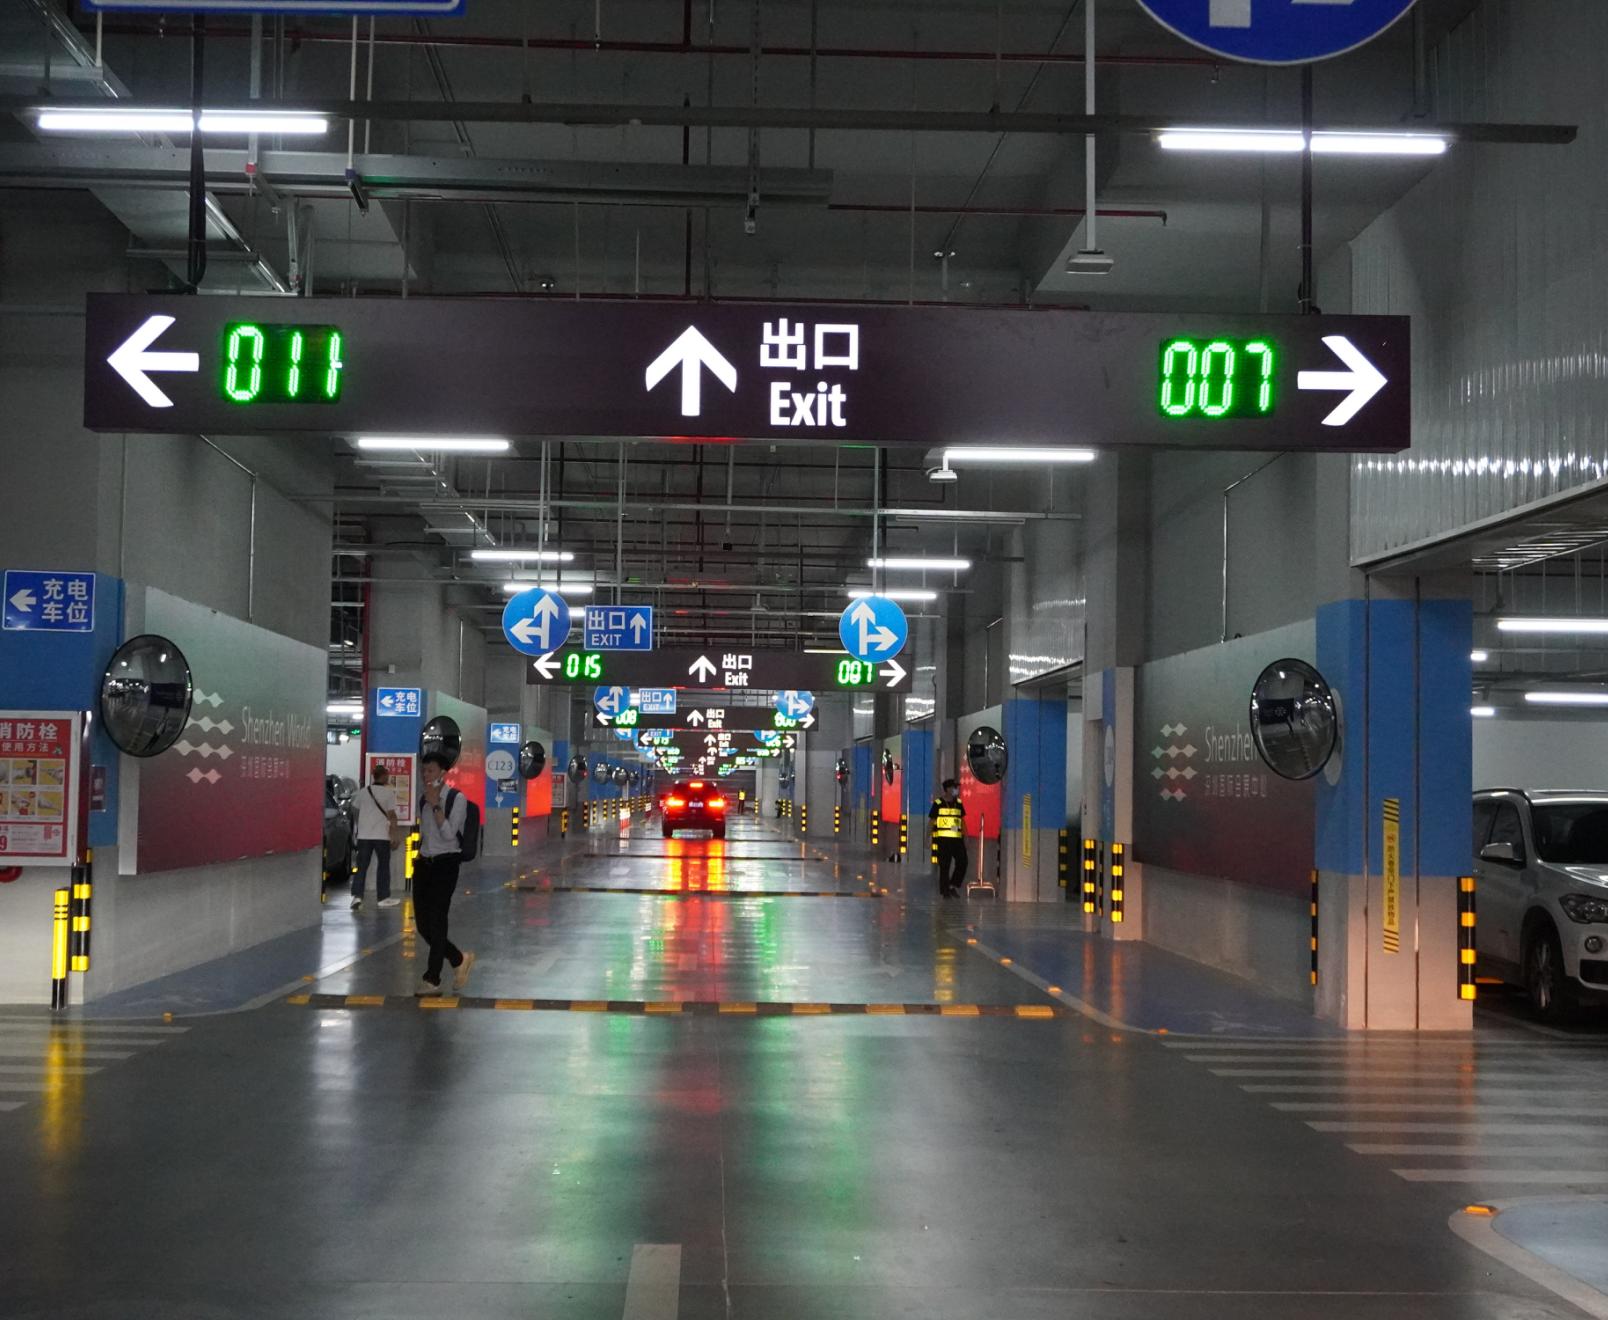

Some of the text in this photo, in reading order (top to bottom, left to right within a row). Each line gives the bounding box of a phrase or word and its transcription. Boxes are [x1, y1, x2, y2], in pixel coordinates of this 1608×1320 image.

[760, 318, 859, 370] 出口
[226, 326, 341, 400] 011
[1161, 342, 1273, 415] 007
[770, 381, 847, 427] Exit
[42, 578, 88, 601] 充电
[41, 601, 88, 623] 车位
[588, 610, 626, 631] 出口
[591, 633, 622, 646] EXIT
[566, 653, 602, 678] 015
[722, 653, 752, 670] 出口
[725, 671, 749, 686] Exit
[641, 691, 662, 703] 出口
[706, 708, 725, 719] 出口
[0, 722, 58, 740] 消防栓
[241, 706, 285, 747] Shenzhen
